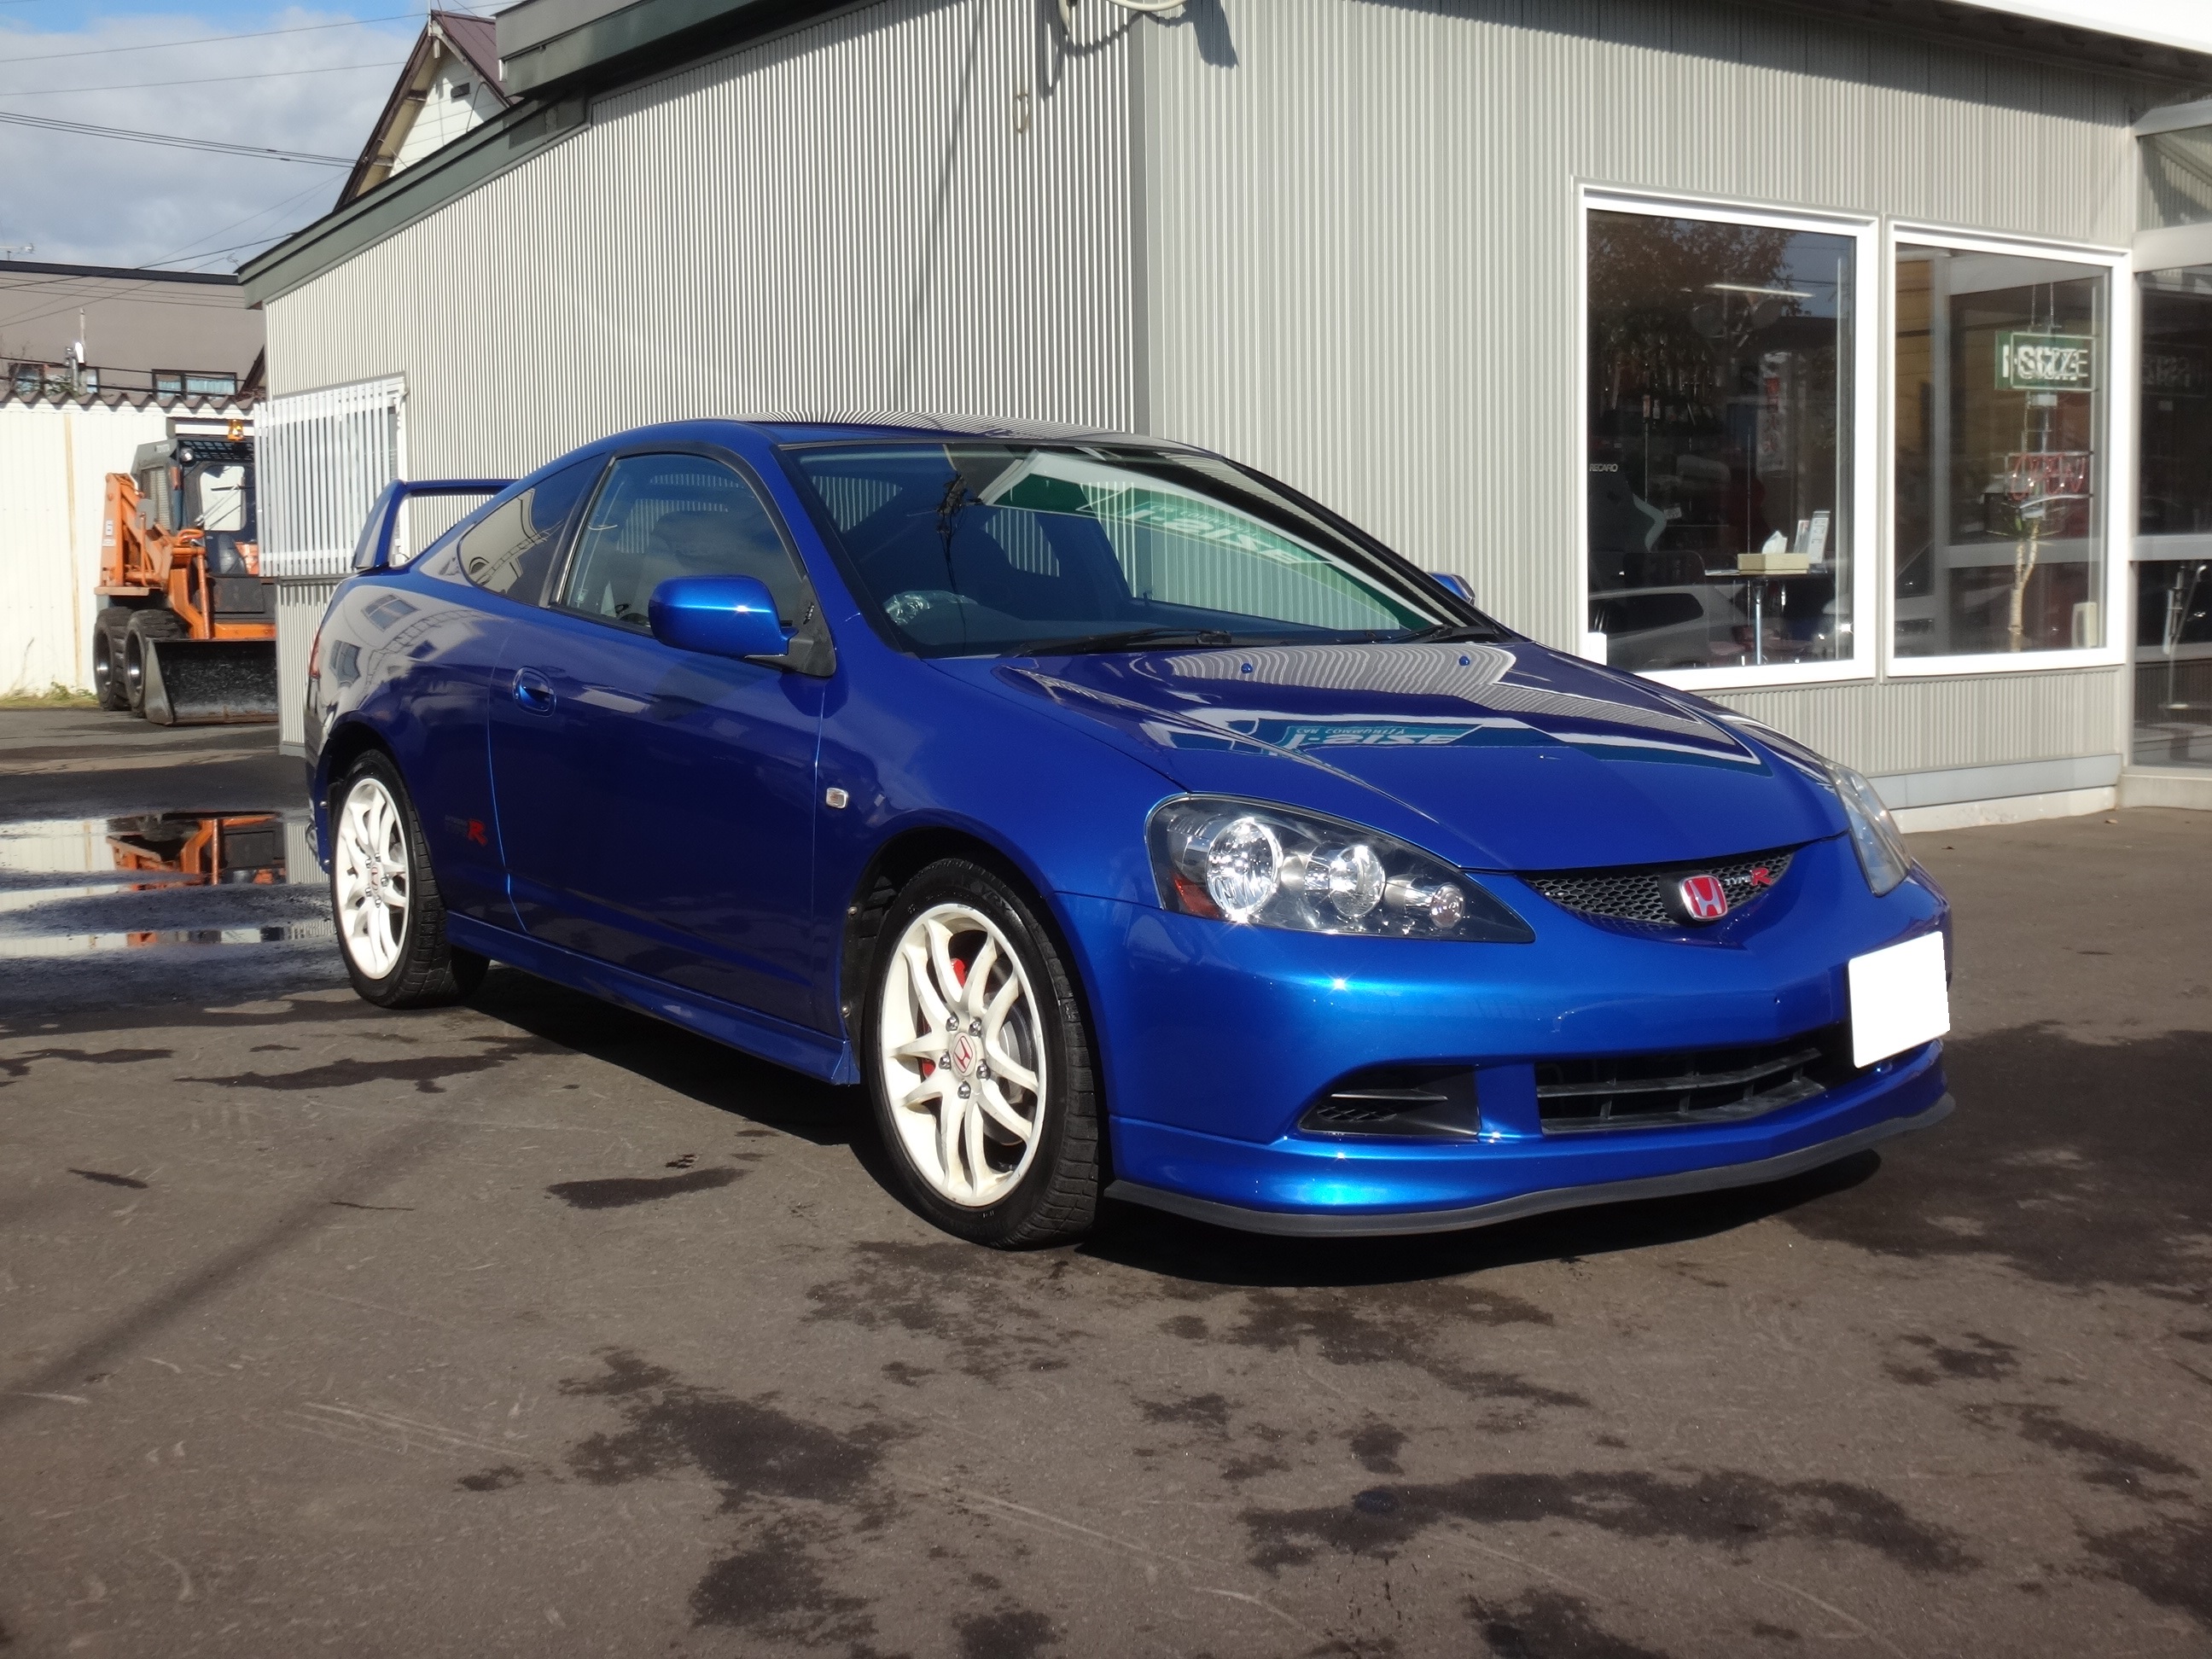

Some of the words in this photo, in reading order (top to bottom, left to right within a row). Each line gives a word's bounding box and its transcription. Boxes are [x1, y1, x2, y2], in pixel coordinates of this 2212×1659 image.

[1589, 463, 1618, 472] RECARO
[468, 818, 488, 847] R
[1725, 875, 1750, 886] TYPE
[1749, 866, 1773, 887] R
